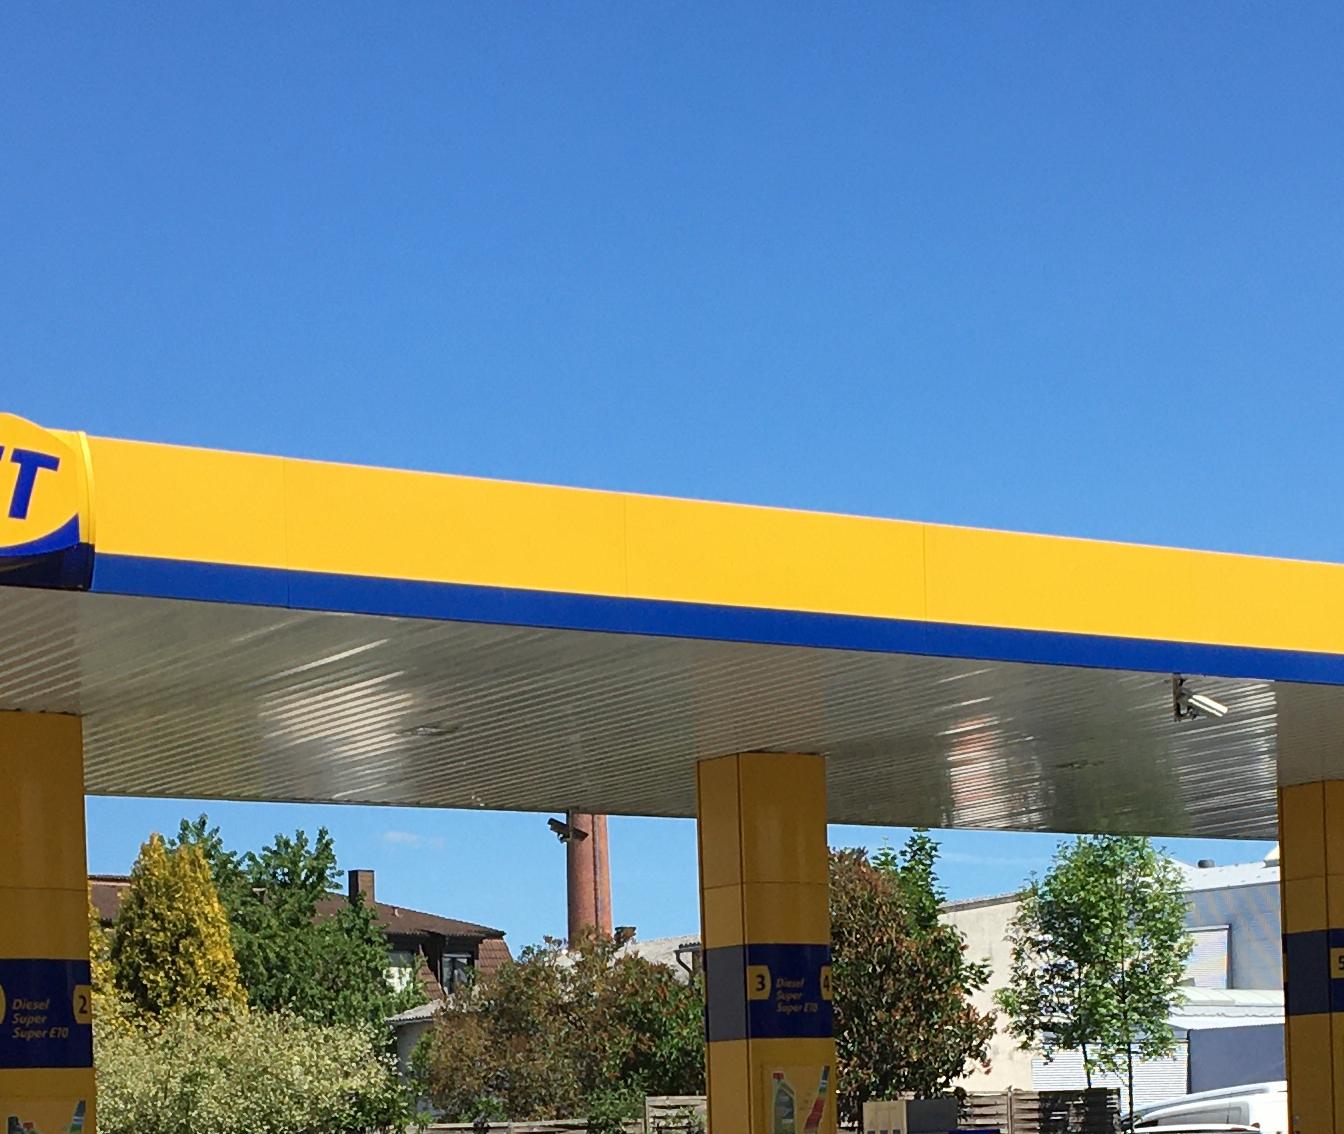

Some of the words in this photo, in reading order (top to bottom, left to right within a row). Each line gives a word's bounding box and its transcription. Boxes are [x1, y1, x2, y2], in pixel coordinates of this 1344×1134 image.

[755, 974, 766, 992] 3
[822, 975, 830, 992] 4
[12, 999, 50, 1010] Diesel
[78, 994, 88, 1014] 2
[12, 1013, 48, 1026] Super
[12, 1027, 47, 1040] Super
[48, 1026, 69, 1039] E10
